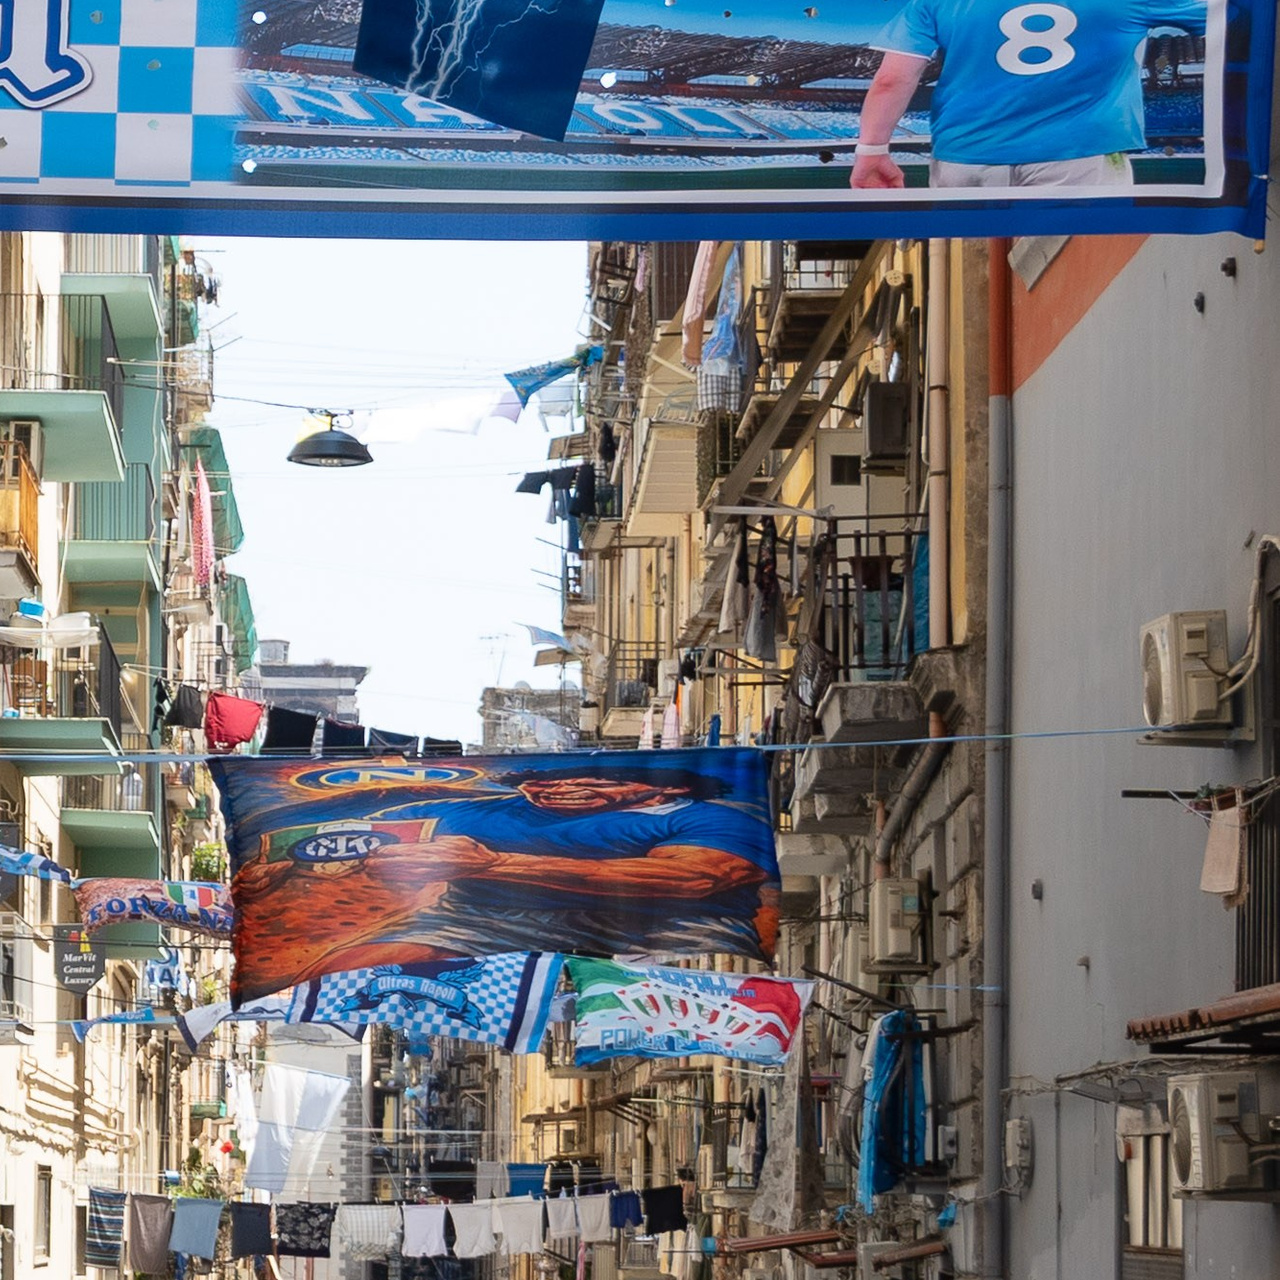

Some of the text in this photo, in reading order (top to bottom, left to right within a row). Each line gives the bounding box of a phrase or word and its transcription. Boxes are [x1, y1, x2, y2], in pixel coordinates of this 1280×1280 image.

[996, 3, 1078, 76] 8
[88, 897, 191, 924] FORZA
[63, 965, 96, 974] Central
[64, 976, 97, 986] Luxury
[377, 976, 458, 1001] Ultras Napoli
